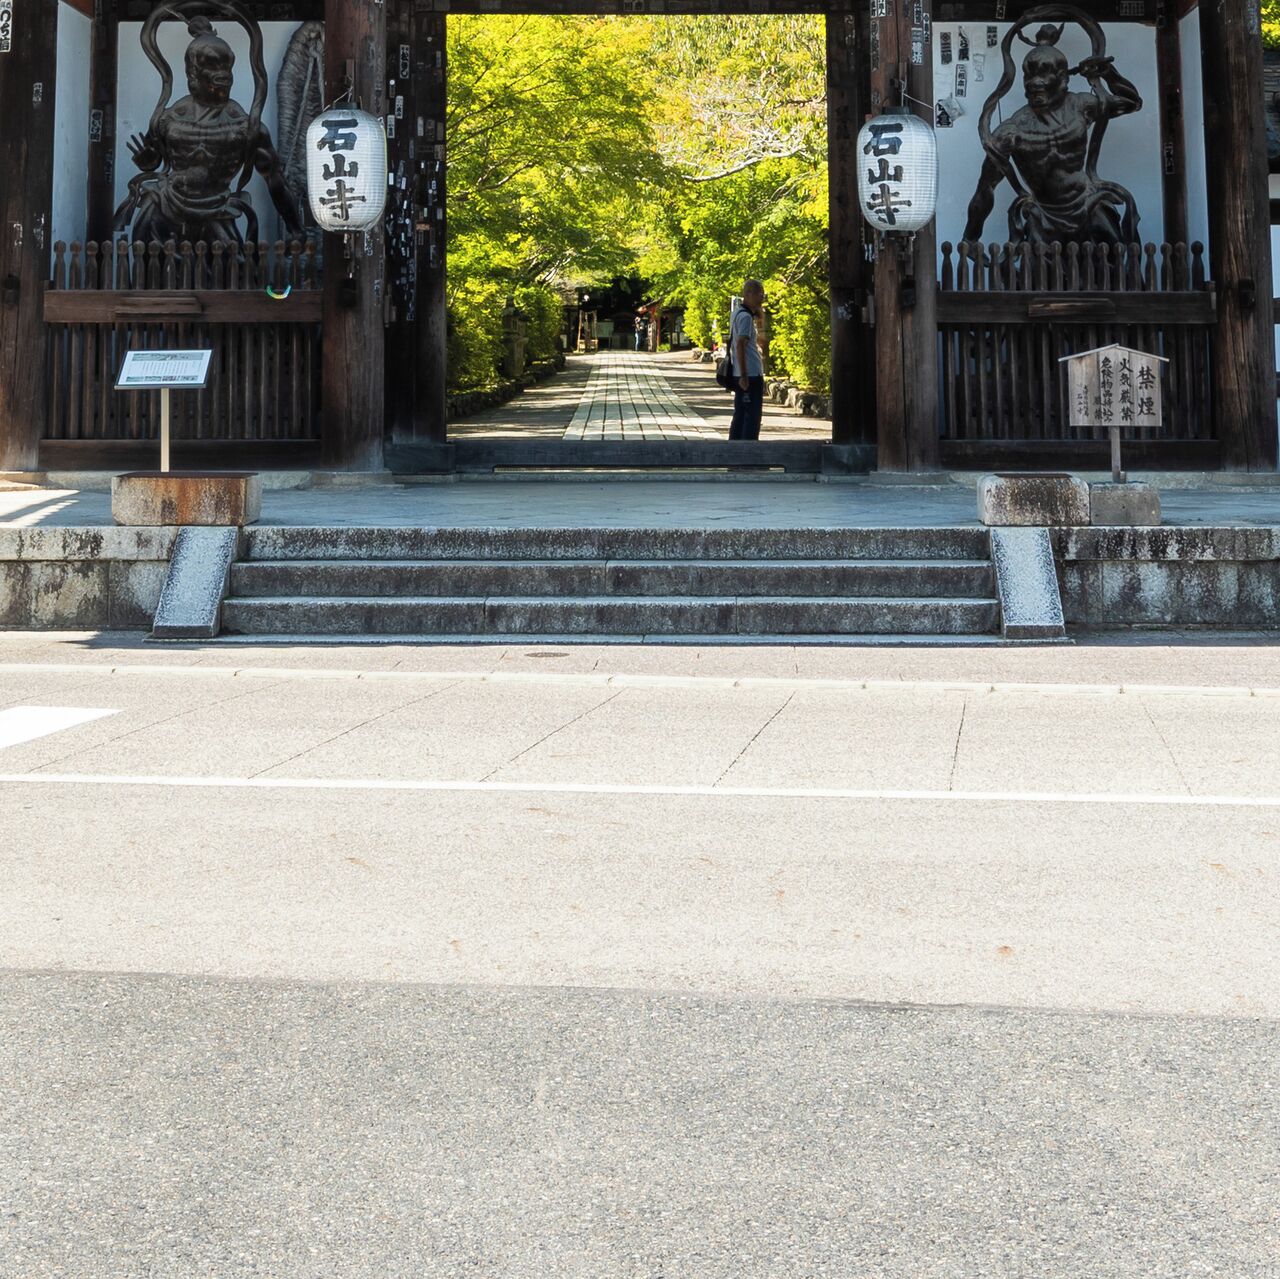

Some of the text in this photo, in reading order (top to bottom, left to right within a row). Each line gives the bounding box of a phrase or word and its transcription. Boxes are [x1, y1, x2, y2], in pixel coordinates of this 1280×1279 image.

[317, 119, 367, 221] 石山寺
[863, 123, 912, 225] 石山寺
[1119, 358, 1134, 422] 火気厳禁
[1137, 365, 1156, 417] 禁煙
